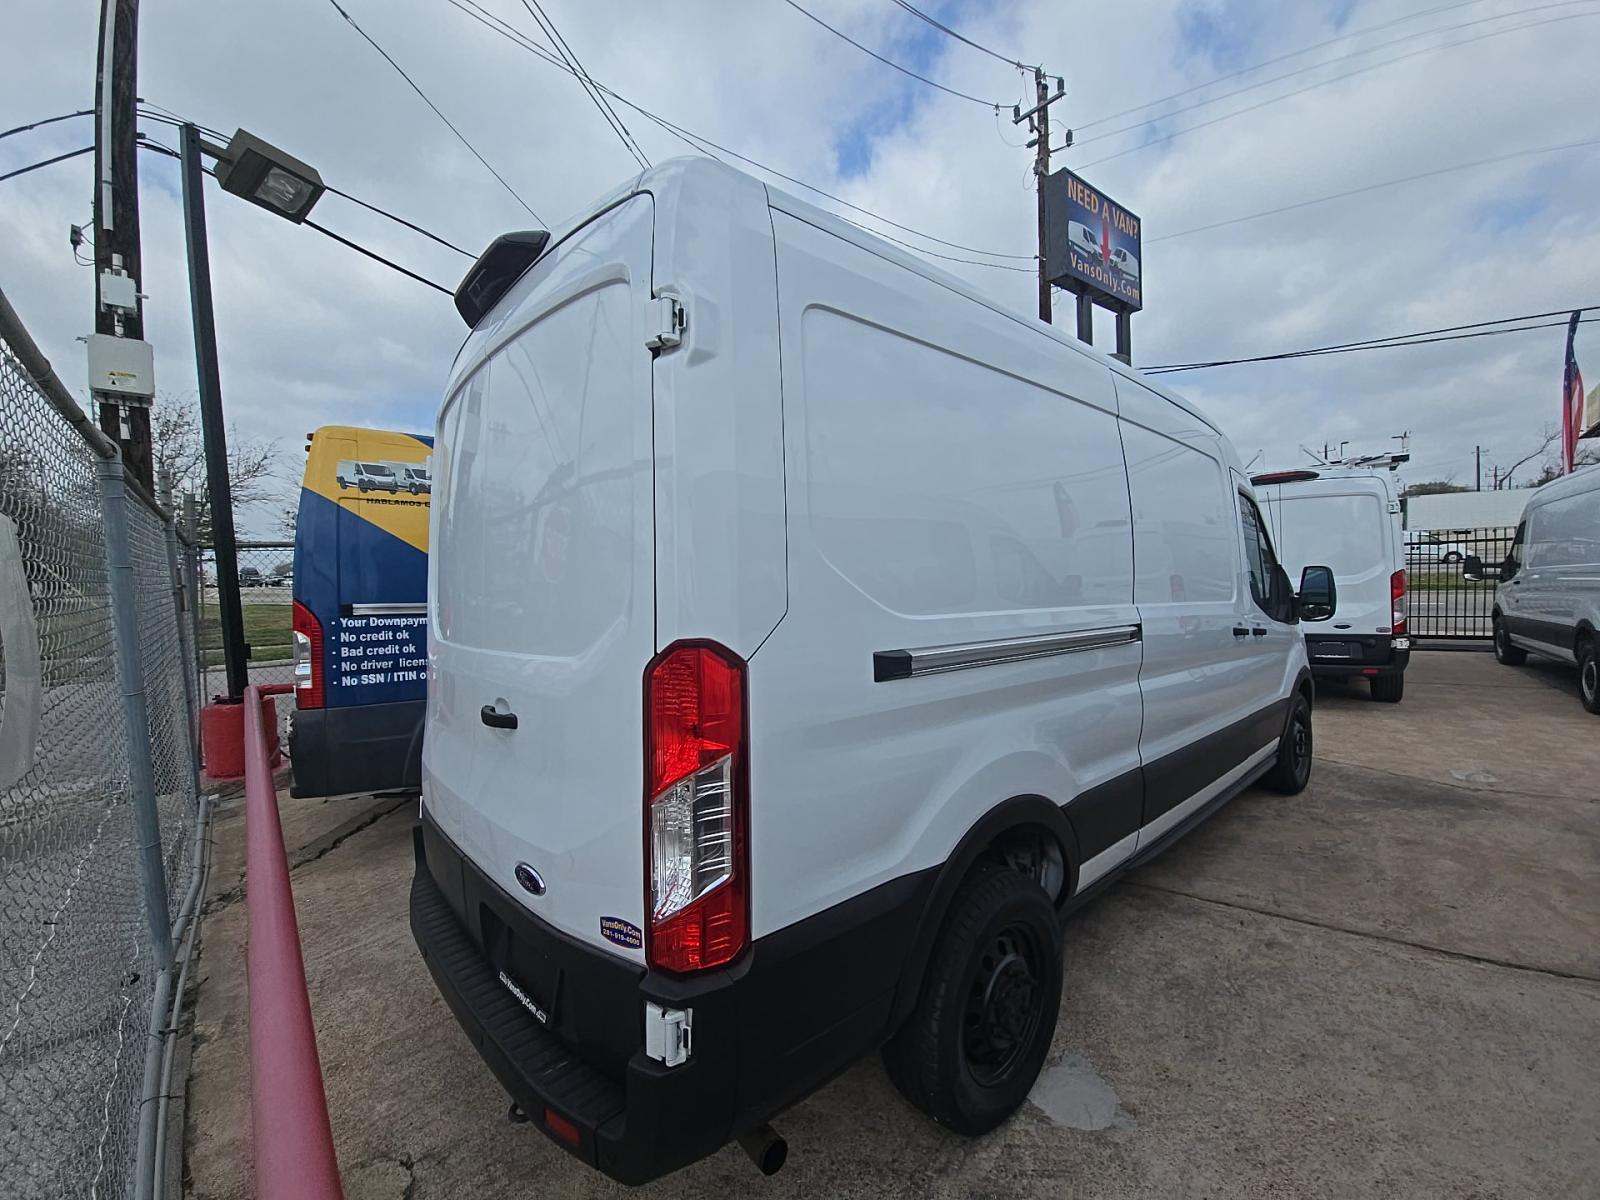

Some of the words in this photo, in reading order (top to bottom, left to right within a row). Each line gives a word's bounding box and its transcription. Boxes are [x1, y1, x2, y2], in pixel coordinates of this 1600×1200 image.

[1068, 177, 1099, 214] NEED
[1101, 201, 1110, 223] A
[1112, 207, 1138, 240] VAN?
[1070, 252, 1140, 300] VansOnly.Com
[366, 498, 421, 507] HABLAMOS
[340, 618, 367, 628] Your
[340, 632, 357, 642] No
[360, 630, 393, 641] credit
[396, 630, 409, 640] ok
[341, 646, 363, 657] Bad
[366, 644, 400, 655] credit
[402, 643, 416, 653] ok
[341, 661, 357, 672] No
[360, 659, 393, 670] driver
[341, 676, 358, 687] No
[361, 672, 385, 684] SSN
[393, 670, 417, 682] ITIN
